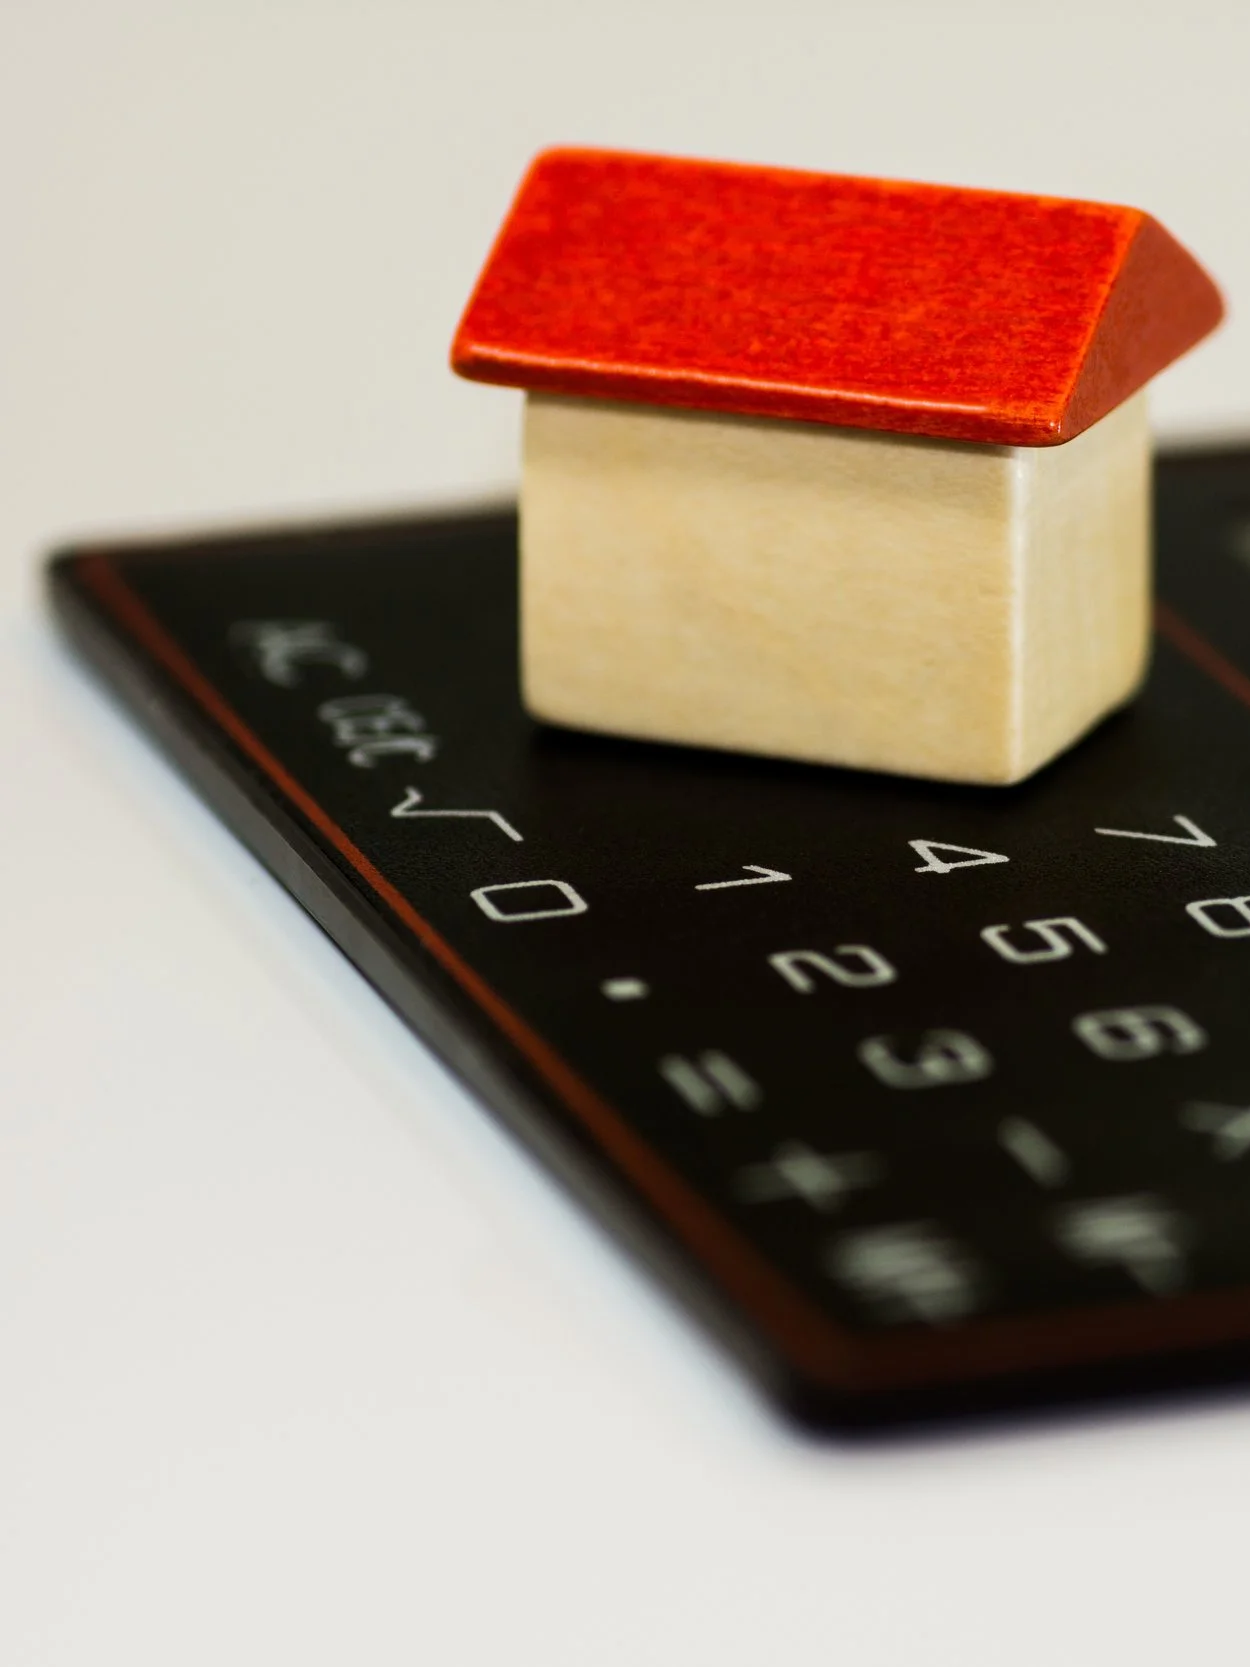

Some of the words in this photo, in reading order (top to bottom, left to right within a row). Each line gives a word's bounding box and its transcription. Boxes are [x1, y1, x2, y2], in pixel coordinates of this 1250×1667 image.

[1095, 815, 1217, 847] 7
[695, 865, 792, 890] 1
[908, 839, 1010, 874] 4
[470, 879, 588, 922] 0
[980, 917, 1106, 963] 5
[769, 945, 896, 992] 2
[1074, 1007, 1205, 1058] 6
[861, 1032, 991, 1086] 3
